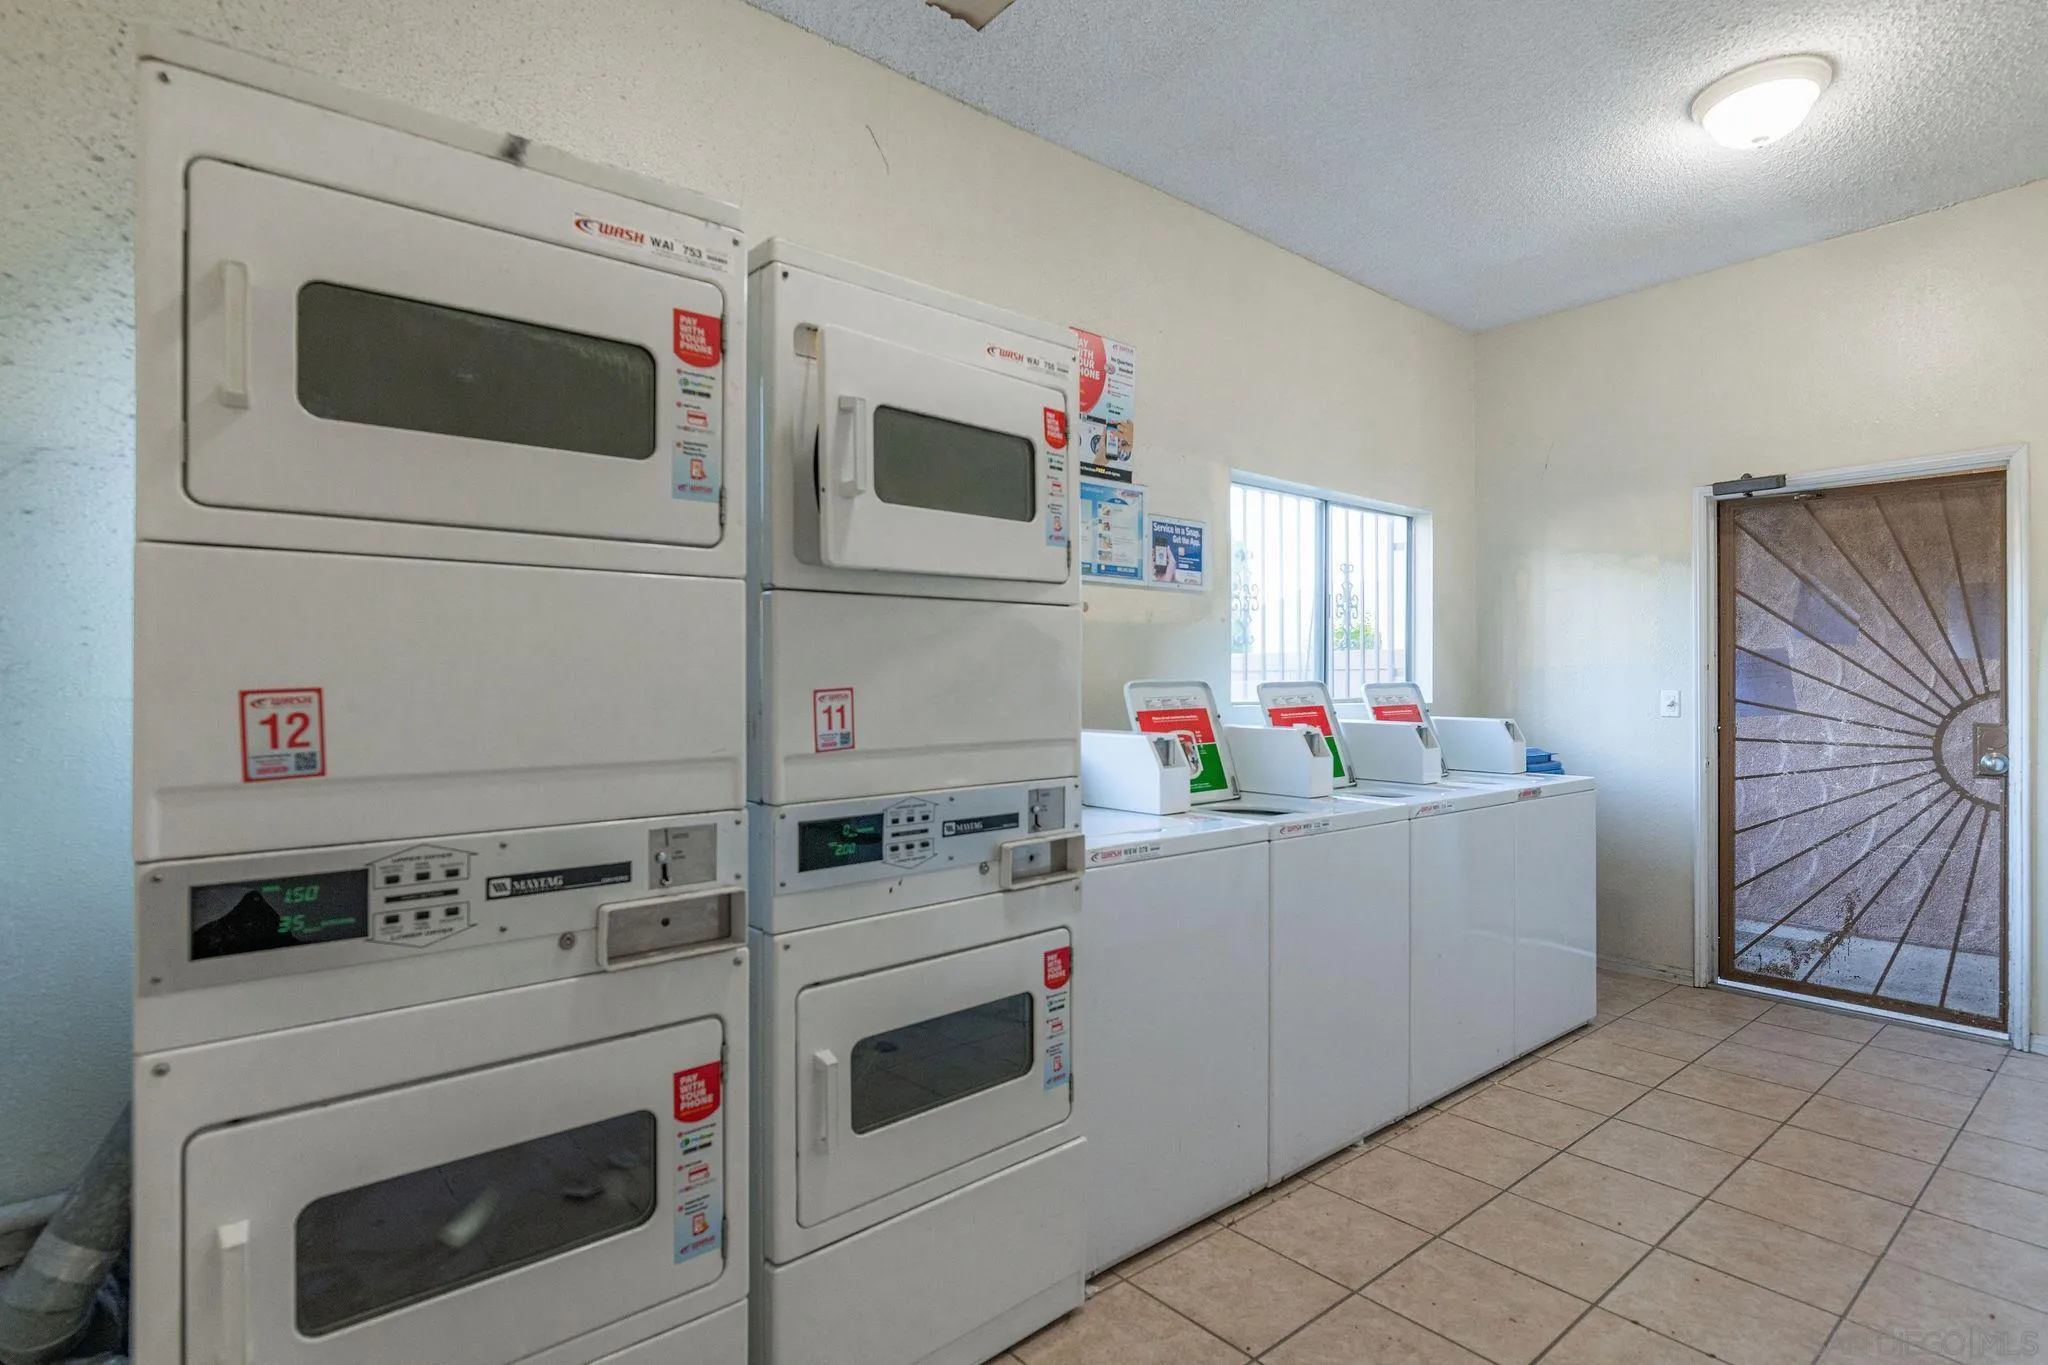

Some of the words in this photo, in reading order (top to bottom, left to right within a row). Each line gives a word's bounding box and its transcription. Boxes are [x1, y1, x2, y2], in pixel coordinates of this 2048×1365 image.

[599, 222, 645, 245] WASH
[679, 323, 705, 336] WITH
[679, 332, 706, 346] YOUR
[679, 341, 713, 356] PHONE
[1079, 366, 1100, 381] HONE
[1153, 522, 1174, 534] Service
[1175, 525, 1180, 535] in
[1172, 534, 1181, 544] Get
[822, 704, 846, 731] 11
[258, 711, 311, 751] 12
[512, 875, 564, 892] MAYTAG
[679, 1073, 698, 1085] PAY
[679, 1080, 706, 1095] WITH
[679, 1088, 707, 1102] YOUR
[679, 1094, 714, 1110] PHONE
